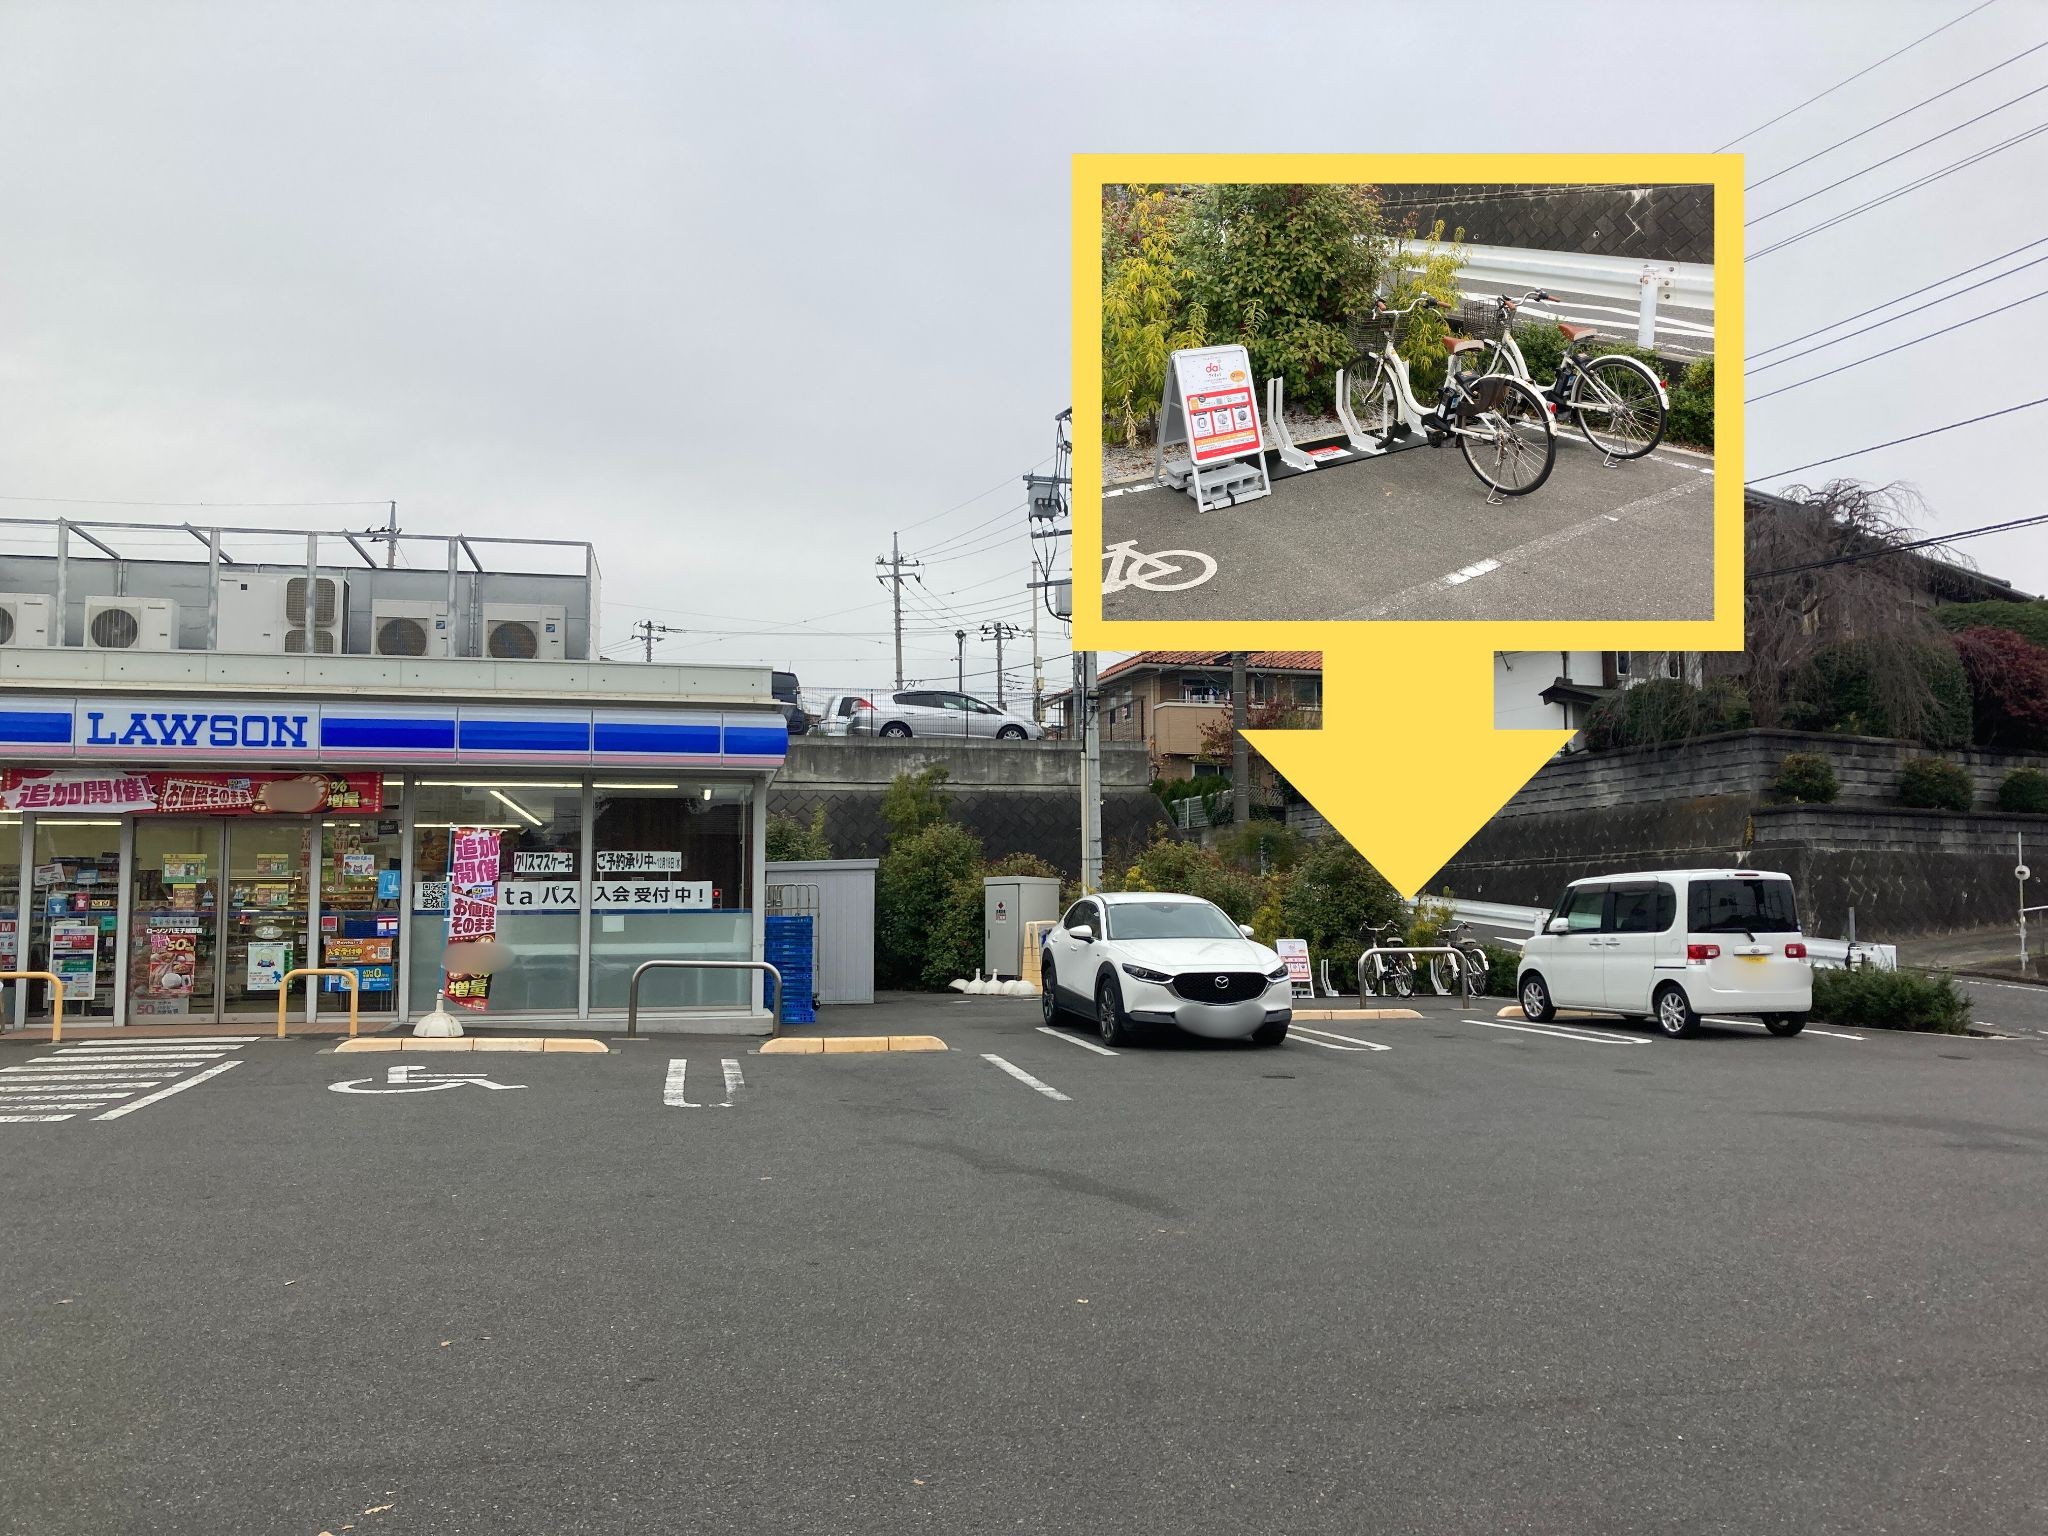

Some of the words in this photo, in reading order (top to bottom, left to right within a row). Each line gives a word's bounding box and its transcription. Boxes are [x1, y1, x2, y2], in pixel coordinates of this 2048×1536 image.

[86, 712, 308, 748] LAWSON
[166, 783, 249, 808] お値段そのまま
[455, 836, 499, 861] 追加
[452, 858, 499, 885] 開催
[514, 853, 573, 873] クリスマスケーキ
[453, 898, 495, 918] お値段
[451, 916, 495, 935] そのまま
[448, 979, 488, 998] 増量
